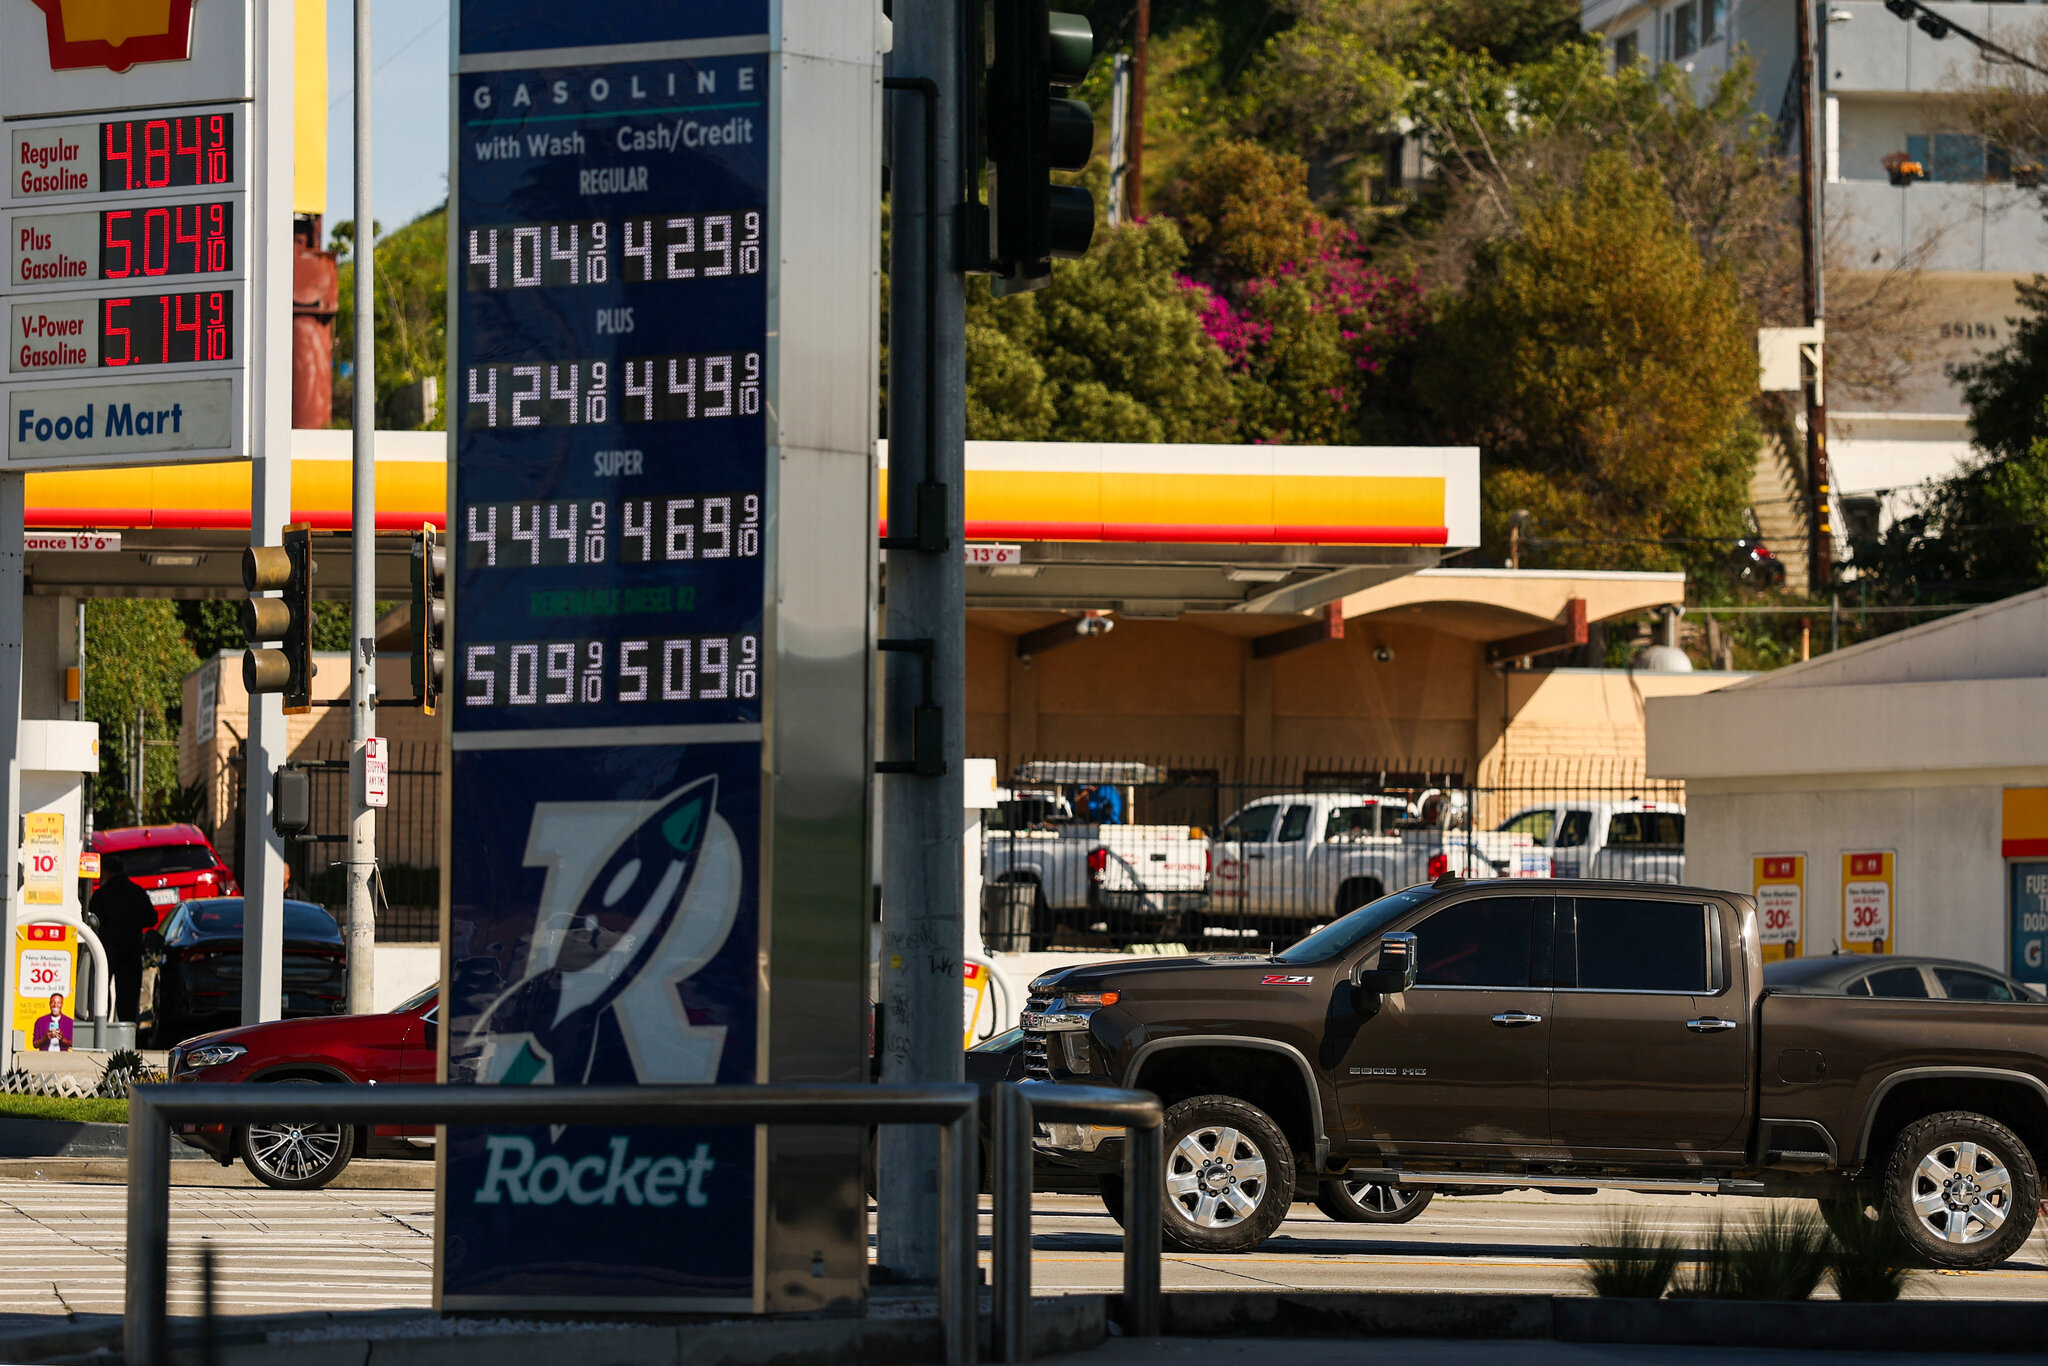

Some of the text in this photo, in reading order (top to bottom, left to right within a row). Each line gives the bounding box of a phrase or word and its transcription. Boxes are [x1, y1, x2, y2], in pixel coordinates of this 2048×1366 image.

[473, 67, 755, 110] GASOLINE
[475, 131, 585, 161] with Wash
[617, 117, 753, 153] Cash/Credit
[21, 138, 79, 169] Regular
[106, 117, 202, 190] 4.84
[21, 167, 88, 193] Gasoline
[580, 166, 649, 196] REGULAR
[21, 227, 51, 251] Plus
[106, 205, 202, 279] 5.04
[21, 254, 87, 280] Gasoline
[21, 315, 84, 338] V-Power
[105, 294, 201, 367] 5.14
[597, 308, 634, 334] PLUS
[20, 341, 87, 367] Gasoline
[18, 403, 182, 442] Food Mart
[594, 449, 643, 477] SUPER
[624, 586, 673, 613] DIESEL
[367, 740, 376, 756] NO
[367, 760, 387, 774] STOPPING
[369, 776, 377, 785] ANY
[1260, 975, 1315, 986] Z71
[474, 1134, 714, 1207] Rocket
